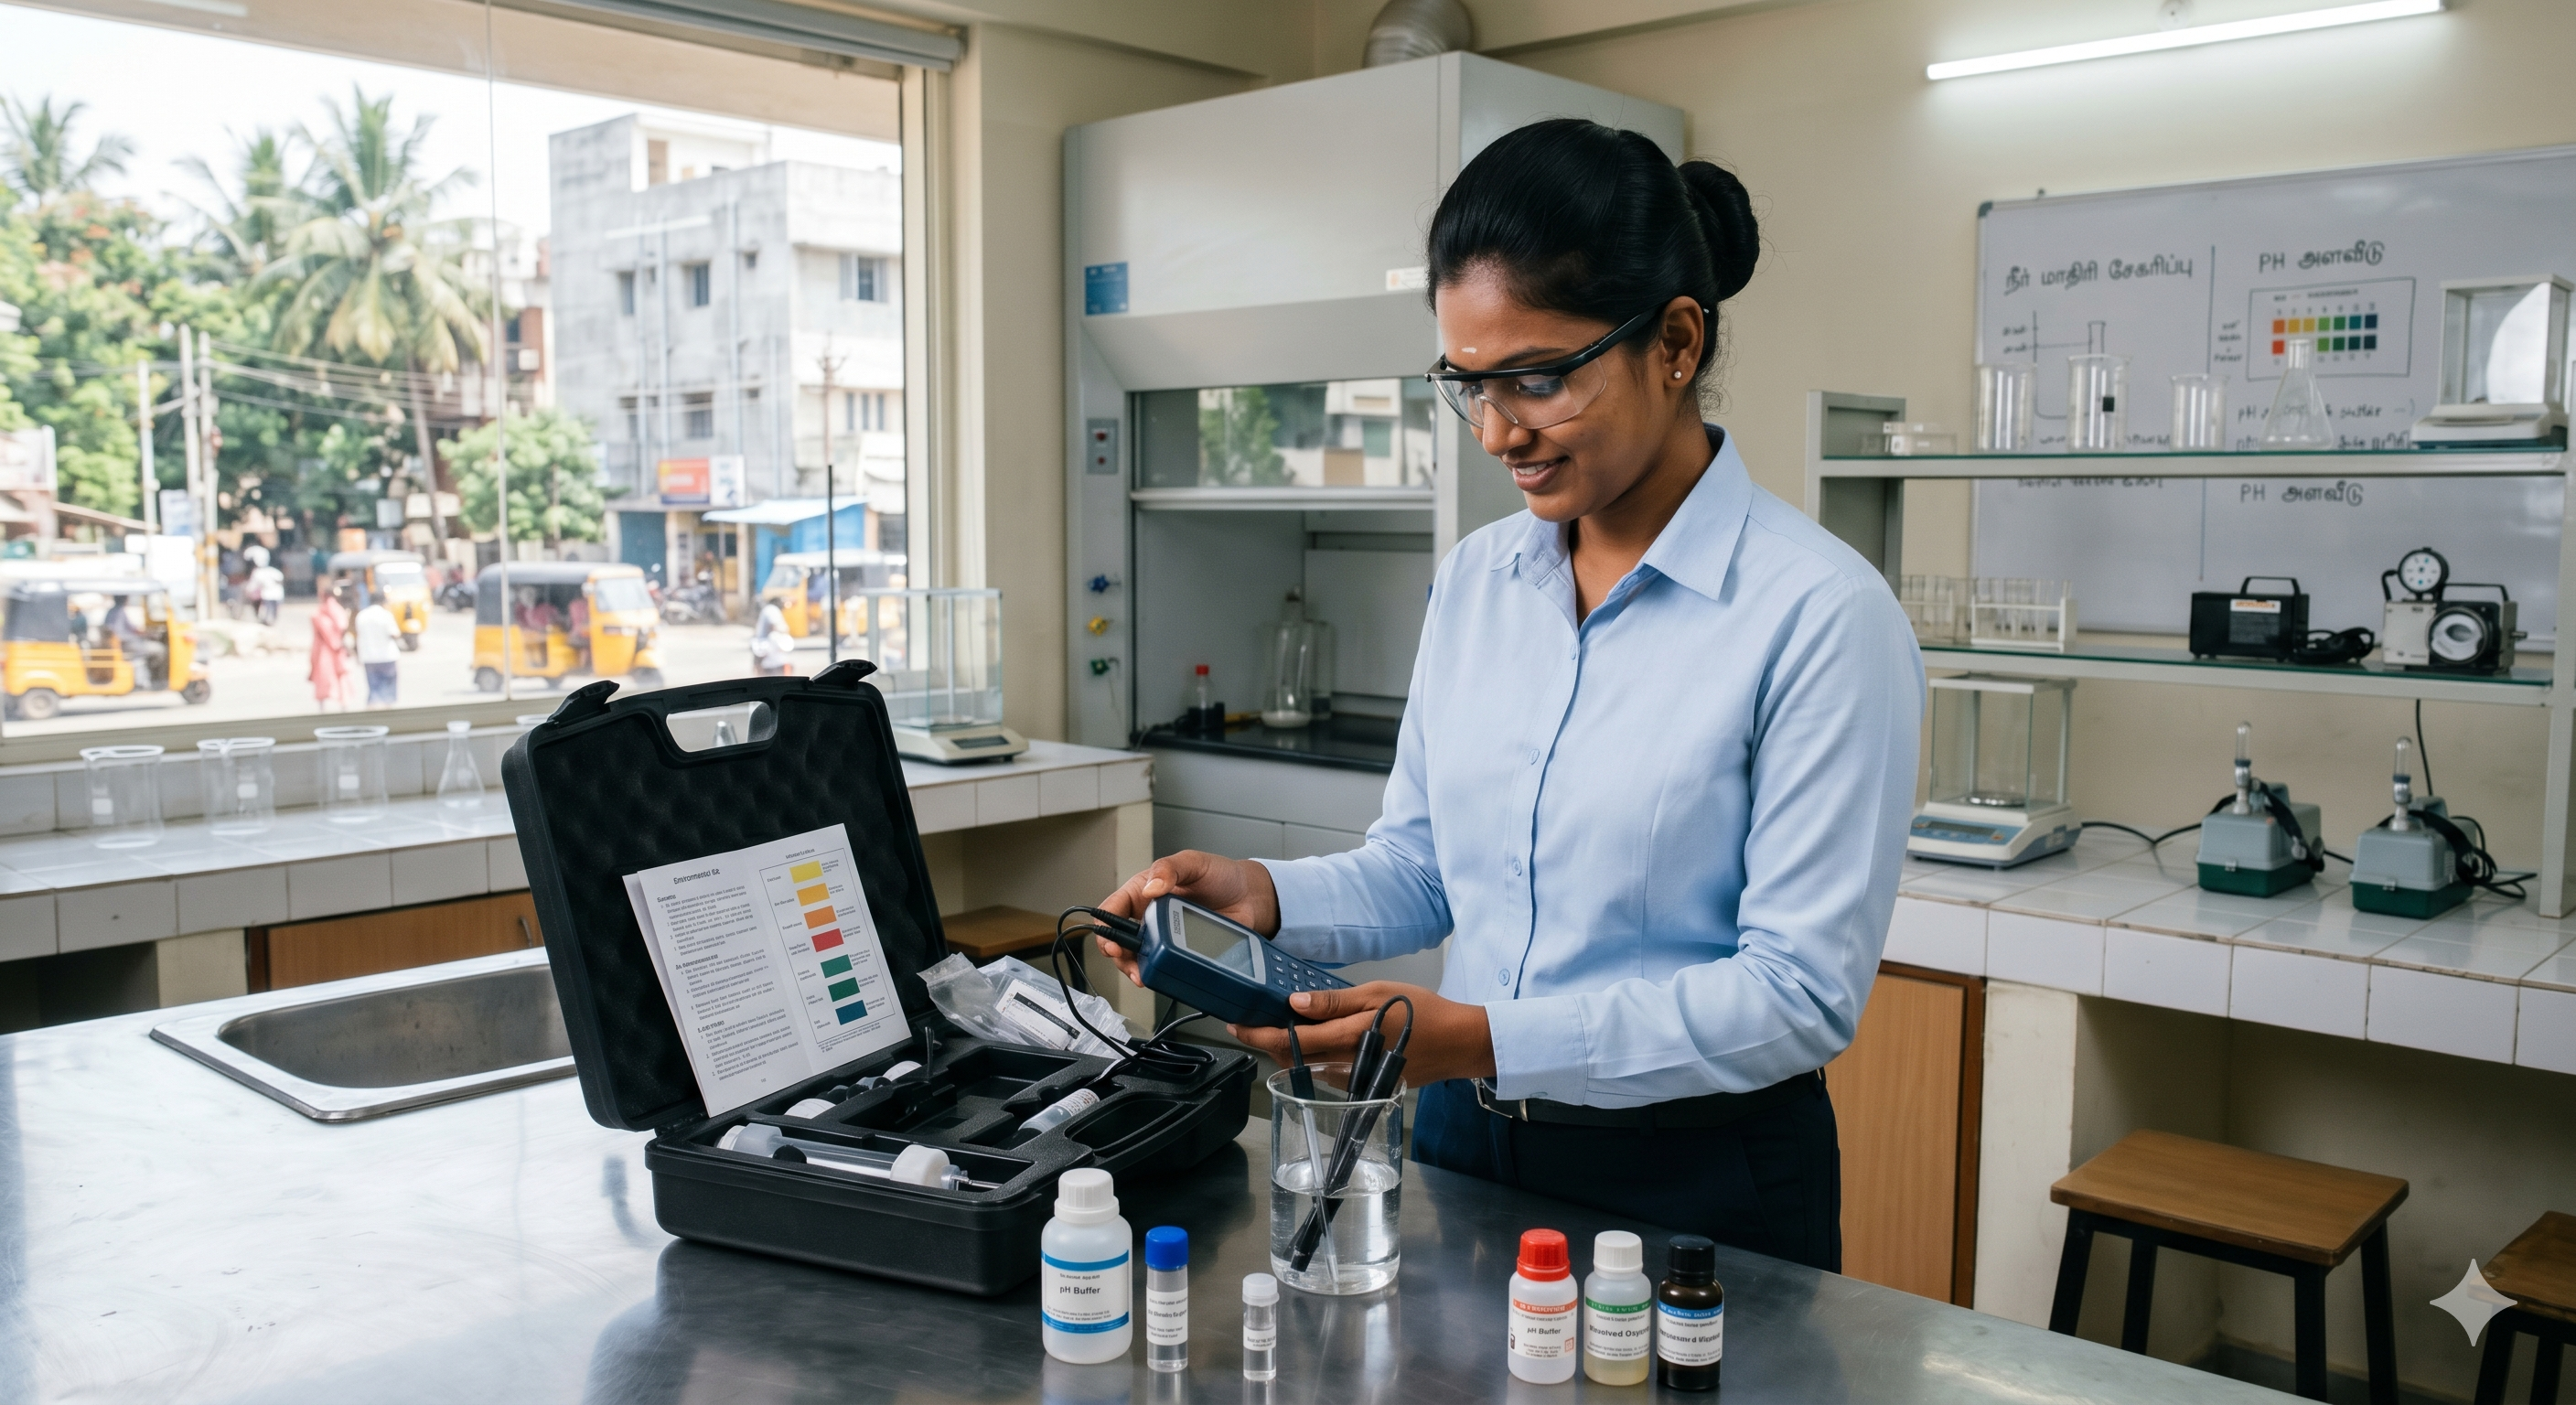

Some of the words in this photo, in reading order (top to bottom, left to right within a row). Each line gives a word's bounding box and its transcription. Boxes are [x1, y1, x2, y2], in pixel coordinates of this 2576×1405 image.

[2259, 252, 2286, 273] PH
[2297, 239, 2386, 270] அளவீடு
[2002, 265, 2030, 296] நீர்
[2041, 260, 2098, 291] மாதிரி
[2108, 252, 2194, 278] சேகரிப்பு
[2240, 483, 2266, 503] PH
[2281, 479, 2365, 507] அளவீடு
[1059, 1286, 1071, 1294] pH
[1073, 1286, 1101, 1295] Buffer
